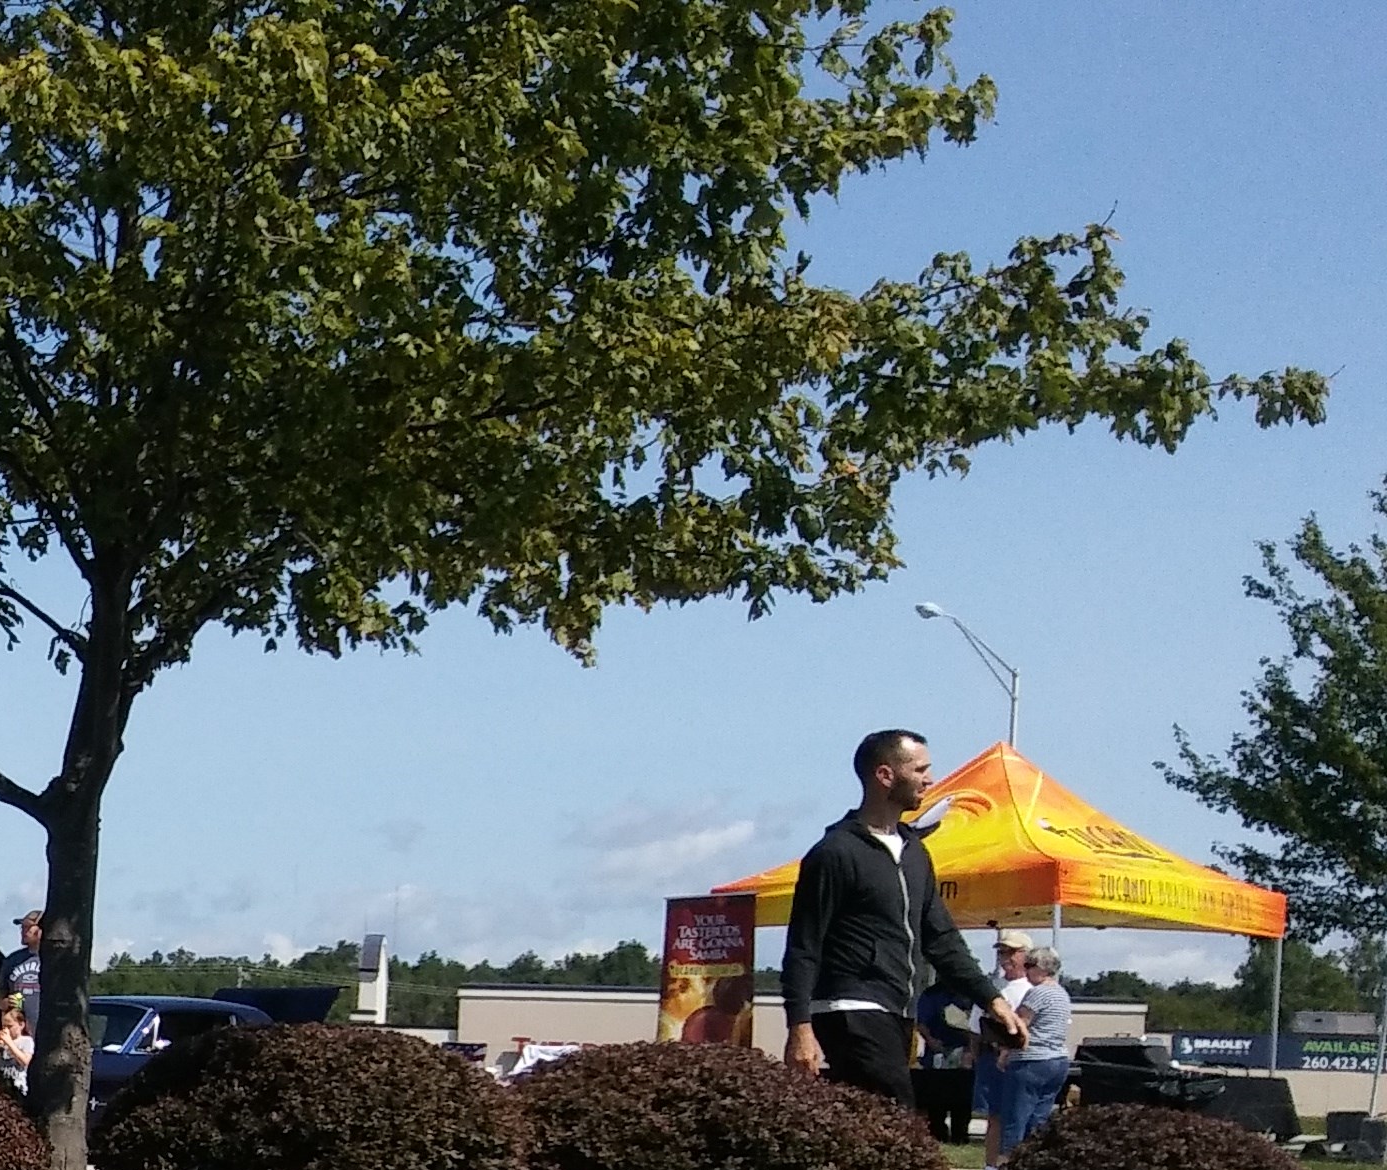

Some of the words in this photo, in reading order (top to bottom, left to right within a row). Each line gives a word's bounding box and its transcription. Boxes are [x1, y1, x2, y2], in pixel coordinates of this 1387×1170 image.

[1098, 873, 1153, 906] TUCANOS
[693, 914, 726, 926] YOUR
[678, 925, 741, 938] TASTEBUDS
[672, 938, 696, 950] ARE
[698, 937, 745, 949] GONNA
[689, 947, 728, 960] SAMBA
[1193, 1038, 1253, 1050] BRADLEY
